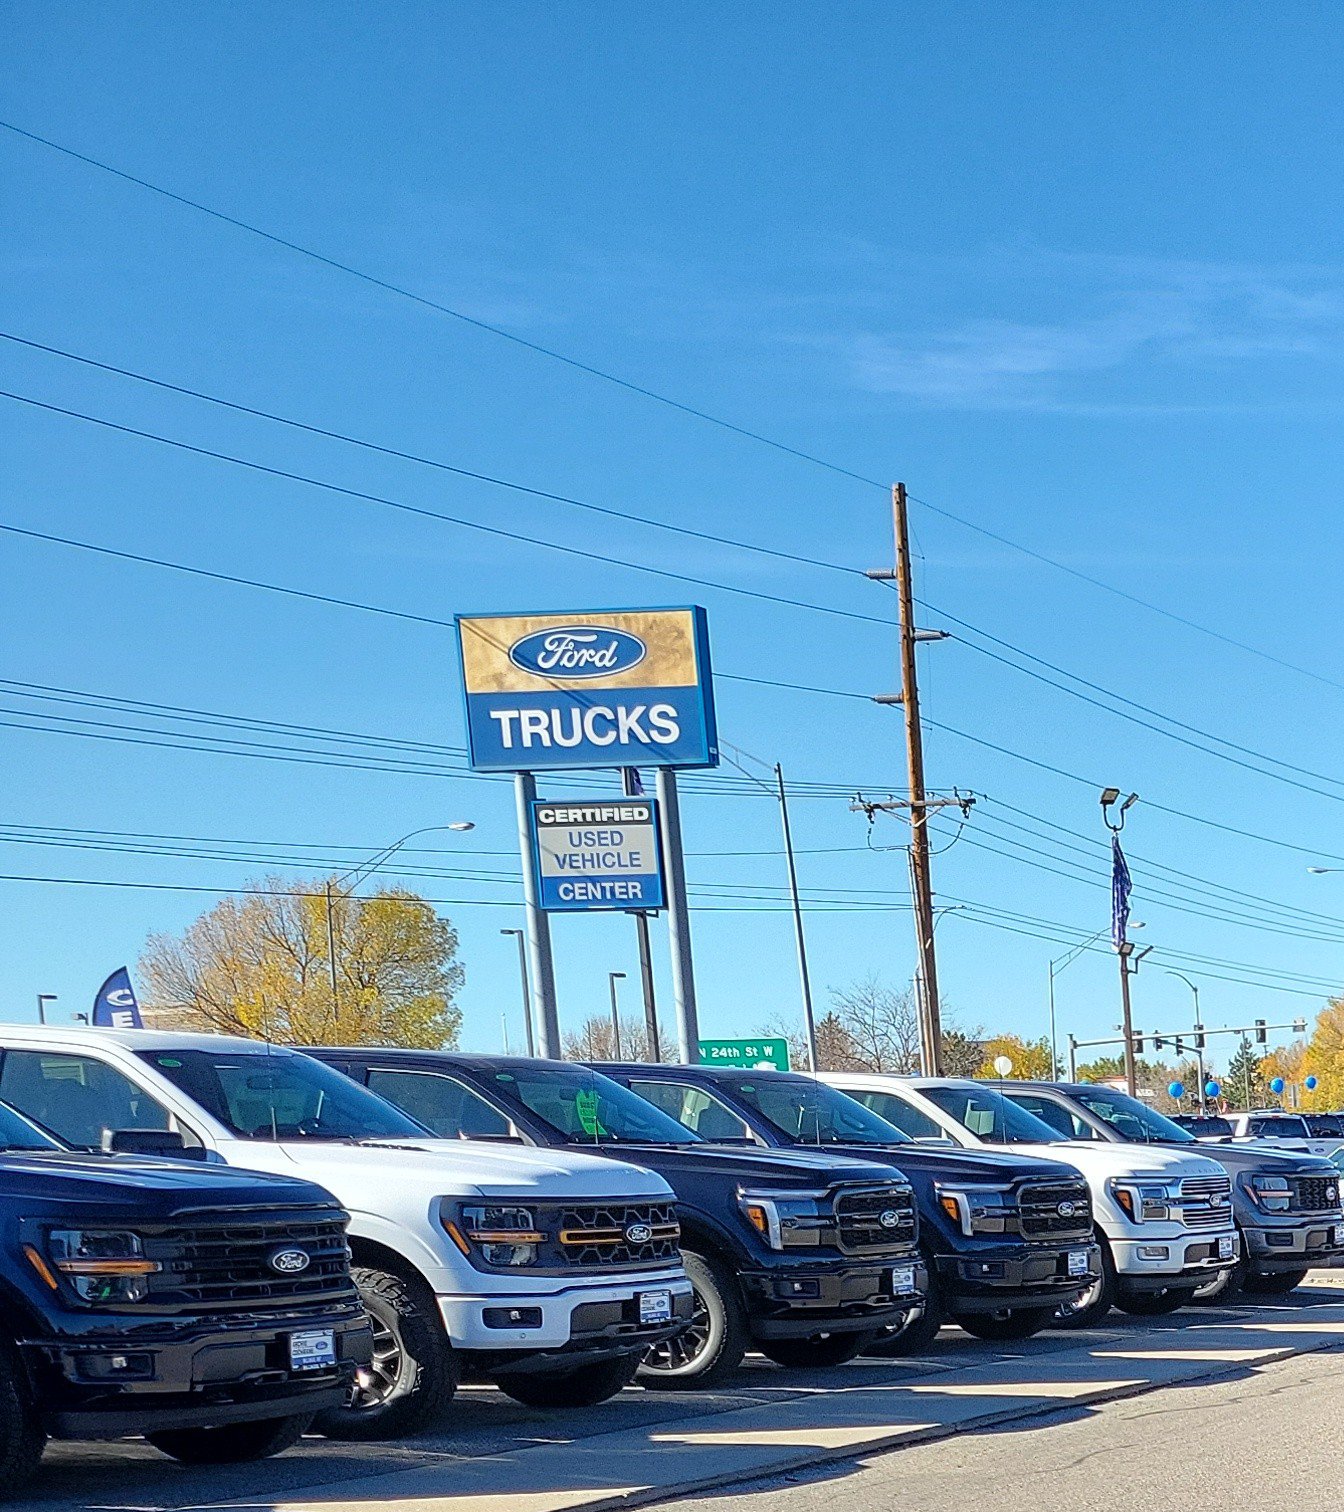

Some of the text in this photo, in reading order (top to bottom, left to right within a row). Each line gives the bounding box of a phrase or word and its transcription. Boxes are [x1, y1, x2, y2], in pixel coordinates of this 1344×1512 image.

[489, 704, 681, 749] TRUCKS
[538, 806, 650, 825] CERTIFIED
[568, 830, 624, 848] USED
[554, 852, 643, 870] VEHICLE
[558, 881, 643, 901] CENTER
[711, 1047, 741, 1058] 24th
[745, 1046, 759, 1057] St
[762, 1045, 774, 1057] W
